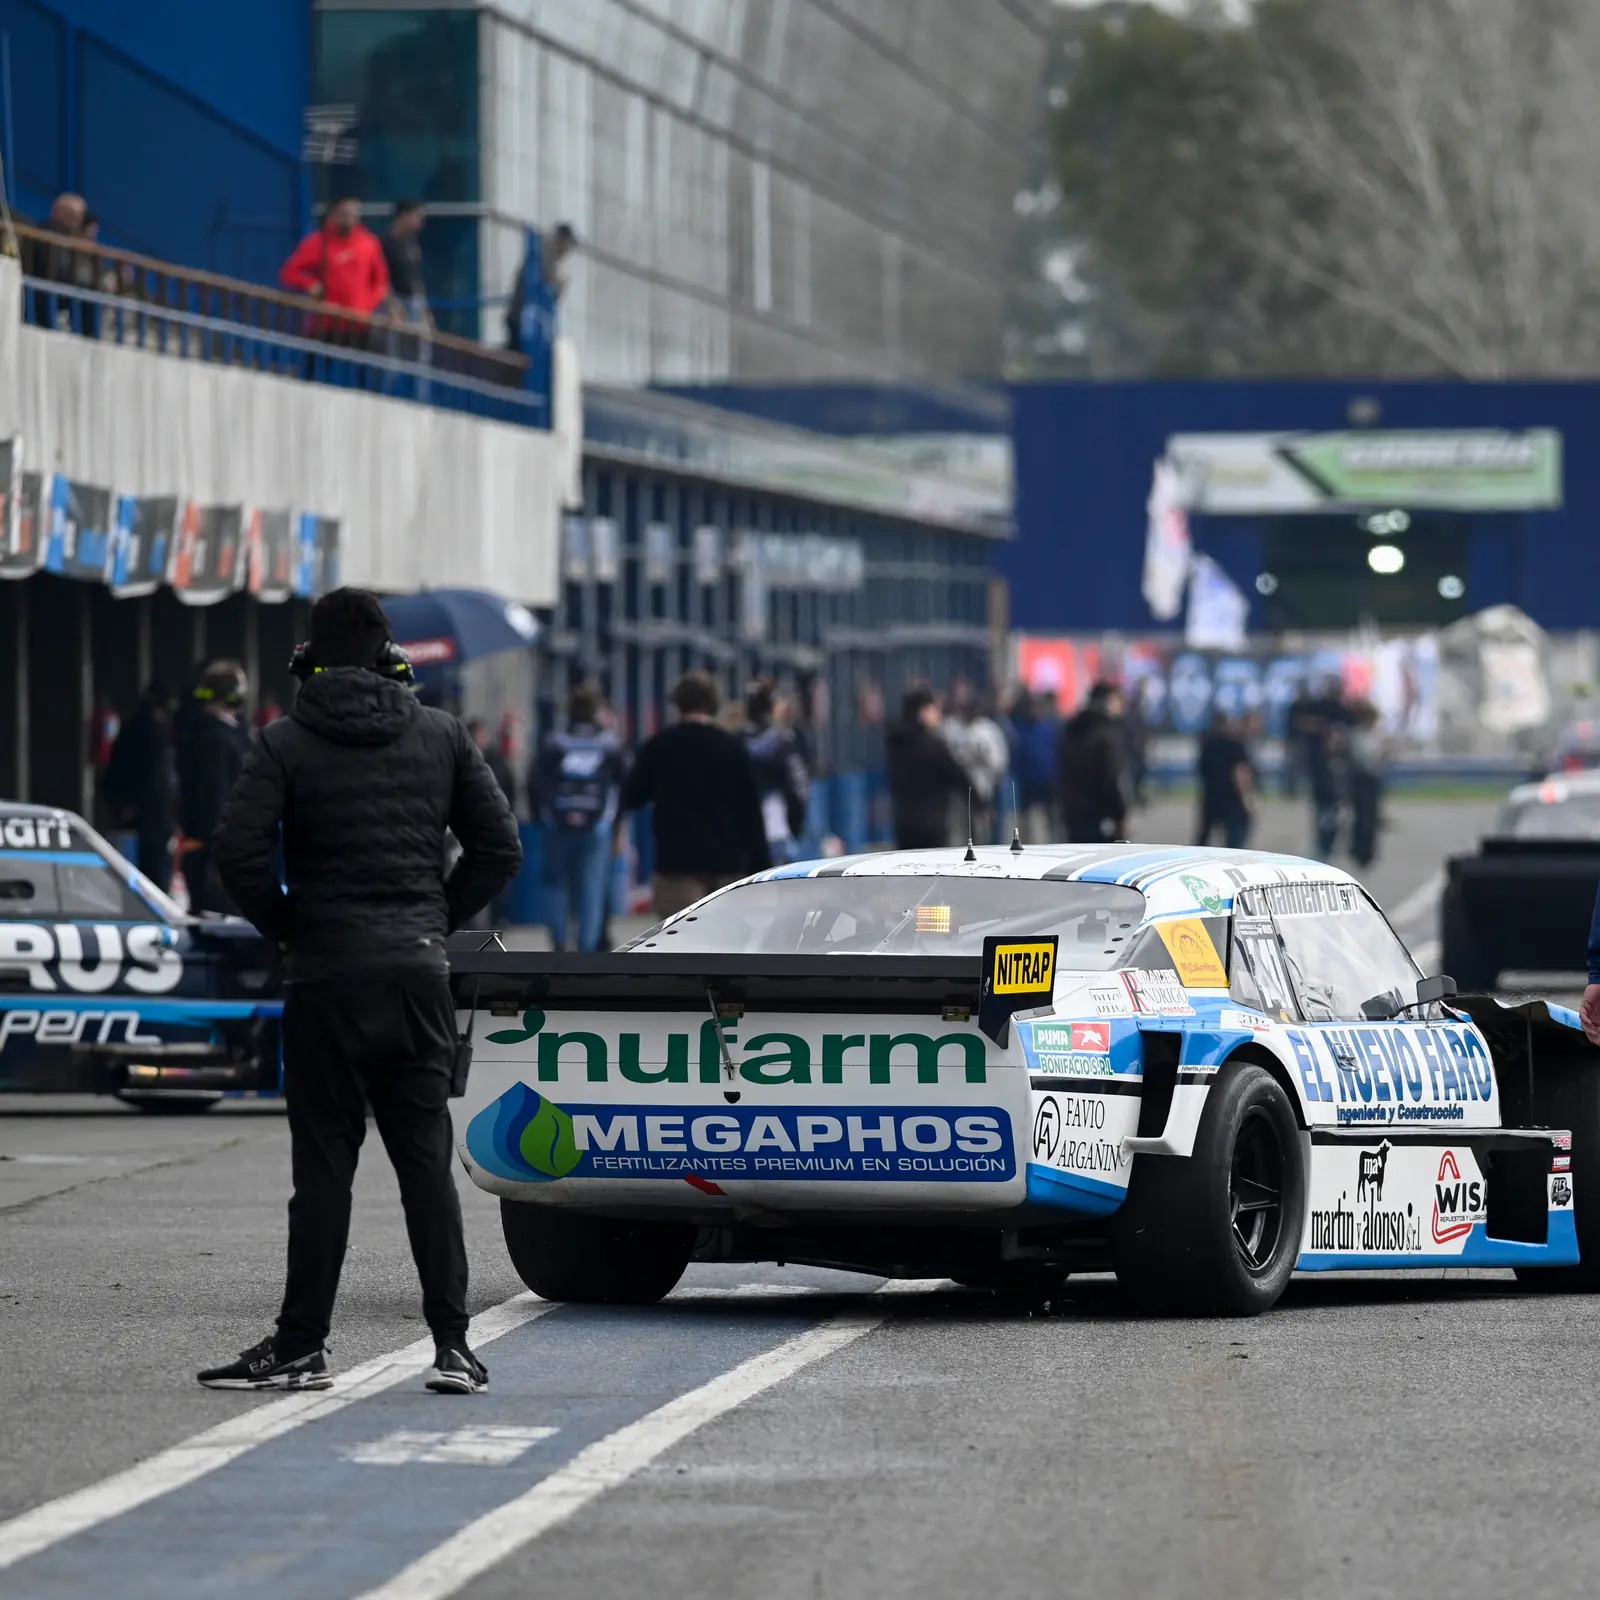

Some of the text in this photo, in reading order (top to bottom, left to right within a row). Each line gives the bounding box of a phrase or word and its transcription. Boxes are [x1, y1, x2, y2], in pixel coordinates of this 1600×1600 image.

[0, 811, 71, 848] ari
[997, 952, 1050, 986] NITRAP
[538, 1017, 986, 1085] nufarm
[1037, 1029, 1069, 1046] PUMA
[1041, 1055, 1090, 1075] BONIFACIO
[1285, 1028, 1492, 1102] EL NUEVO FARO
[1065, 1097, 1105, 1130] FAVIO
[1337, 1104, 1464, 1123] Ingeniería y Construcción
[572, 1115, 1003, 1153] MEGAPHOS
[592, 1154, 1006, 1172] FERTILIZANTES PREMIUM EN SOLUCIÓN
[1056, 1138, 1124, 1172] ARGAÑIN
[1362, 1188, 1405, 1250] alonso
